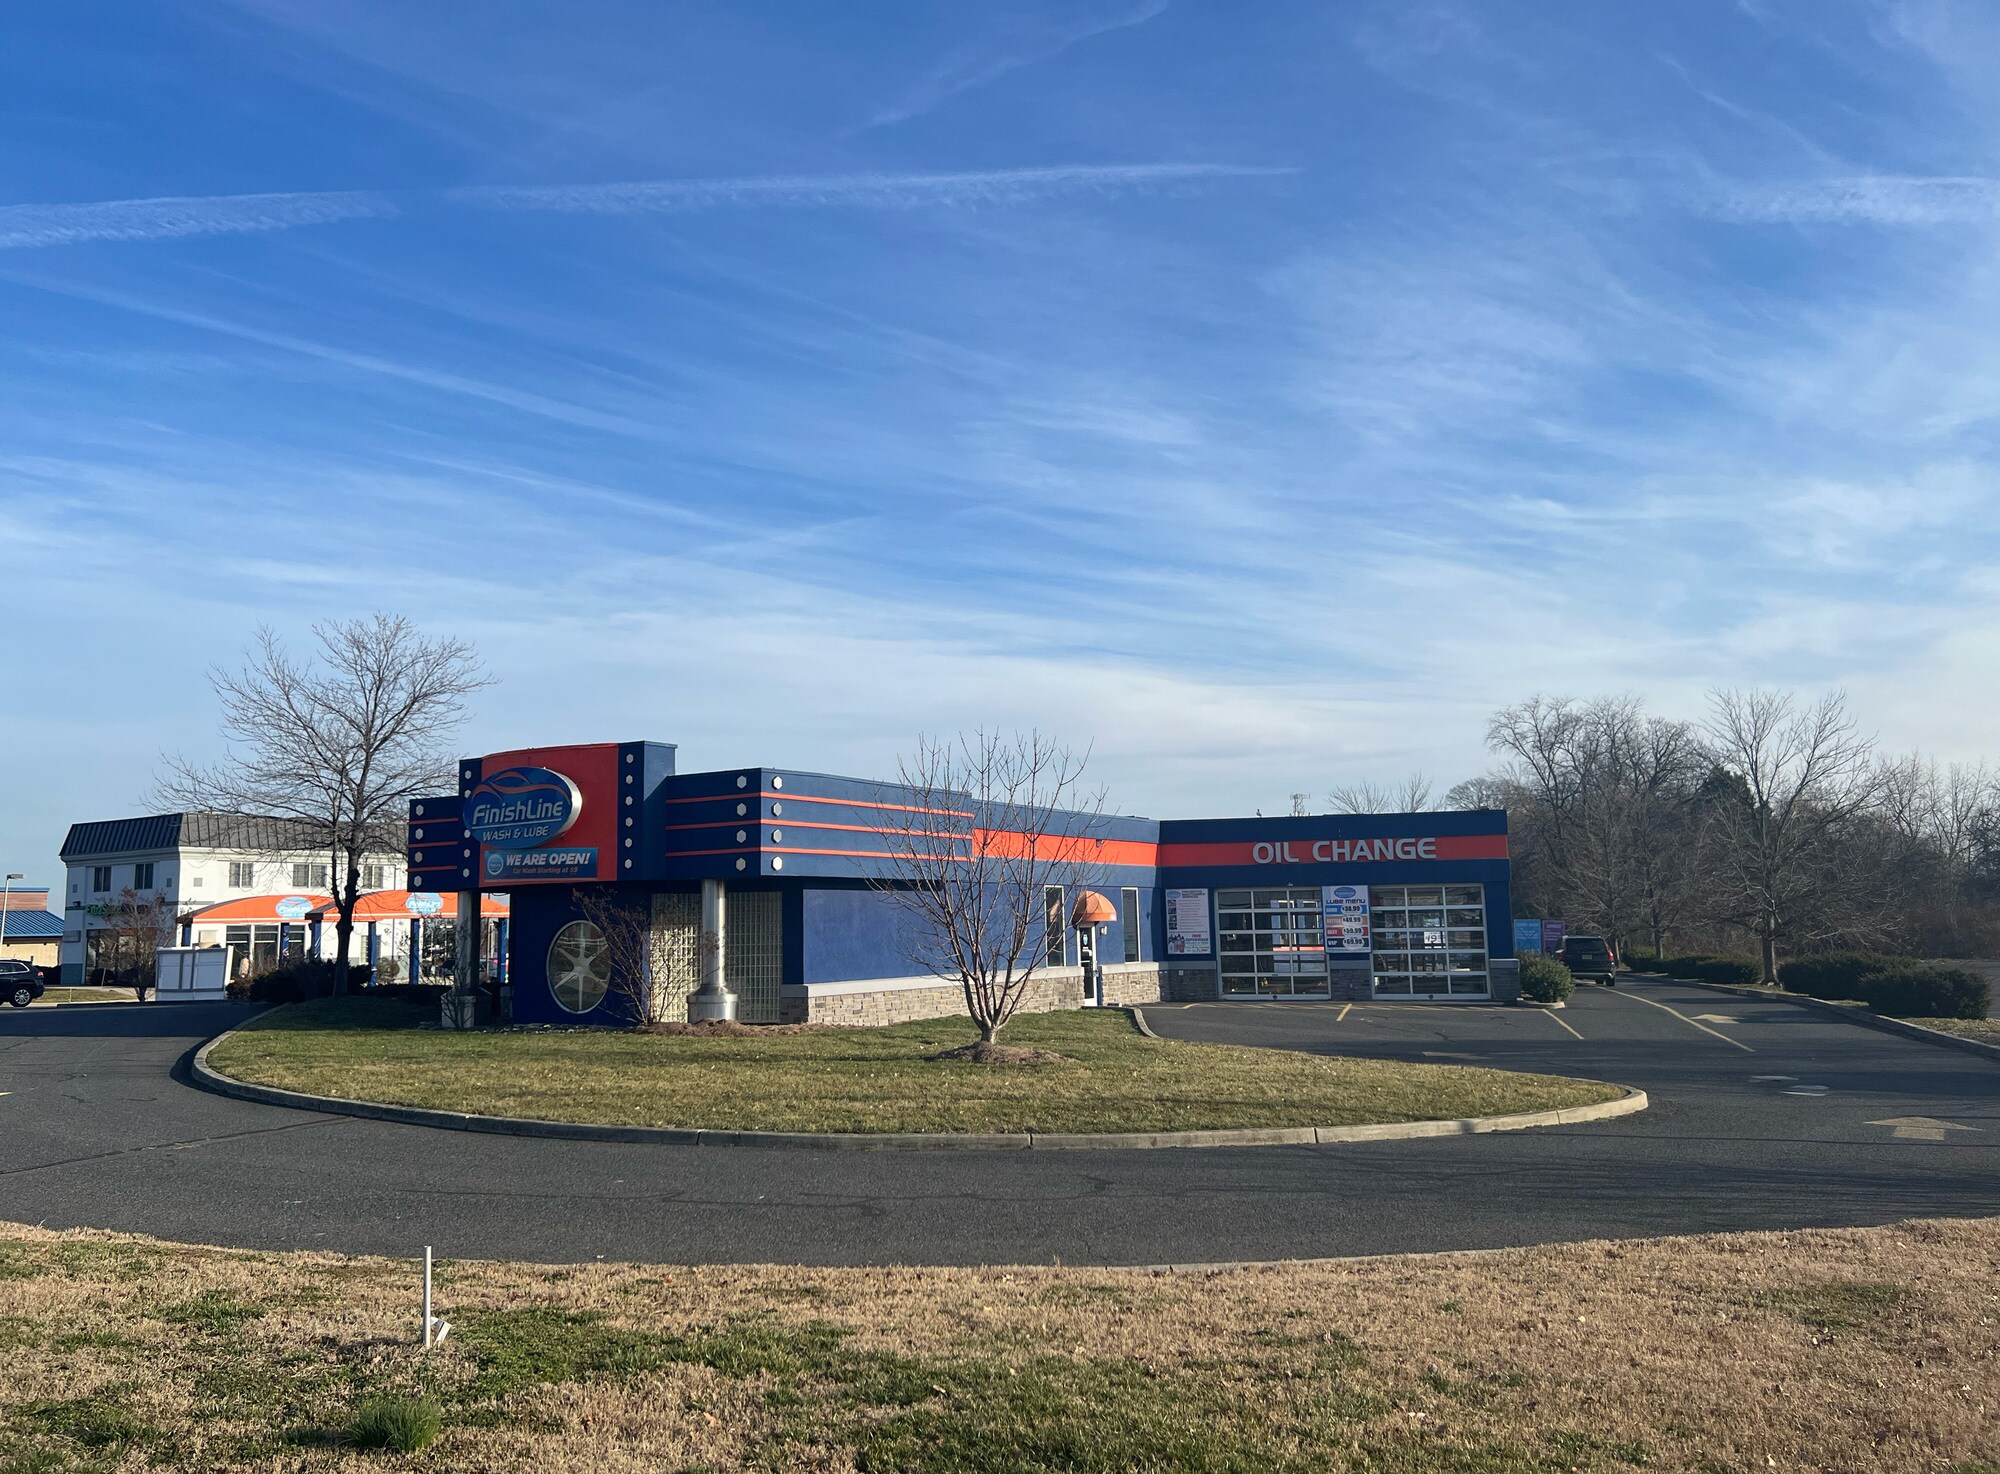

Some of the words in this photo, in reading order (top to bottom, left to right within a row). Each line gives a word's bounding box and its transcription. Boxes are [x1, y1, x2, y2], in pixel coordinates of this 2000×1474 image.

[472, 799, 563, 825] FinishLine
[483, 828, 511, 841] WASH
[514, 828, 523, 838] &
[524, 826, 549, 837] LUBE
[1252, 841, 1300, 864] OIL
[1312, 837, 1437, 862] CHANGE
[506, 854, 522, 866] WE
[522, 853, 547, 866] ARE
[549, 852, 591, 865] OPEN!
[537, 867, 561, 875] Starting
